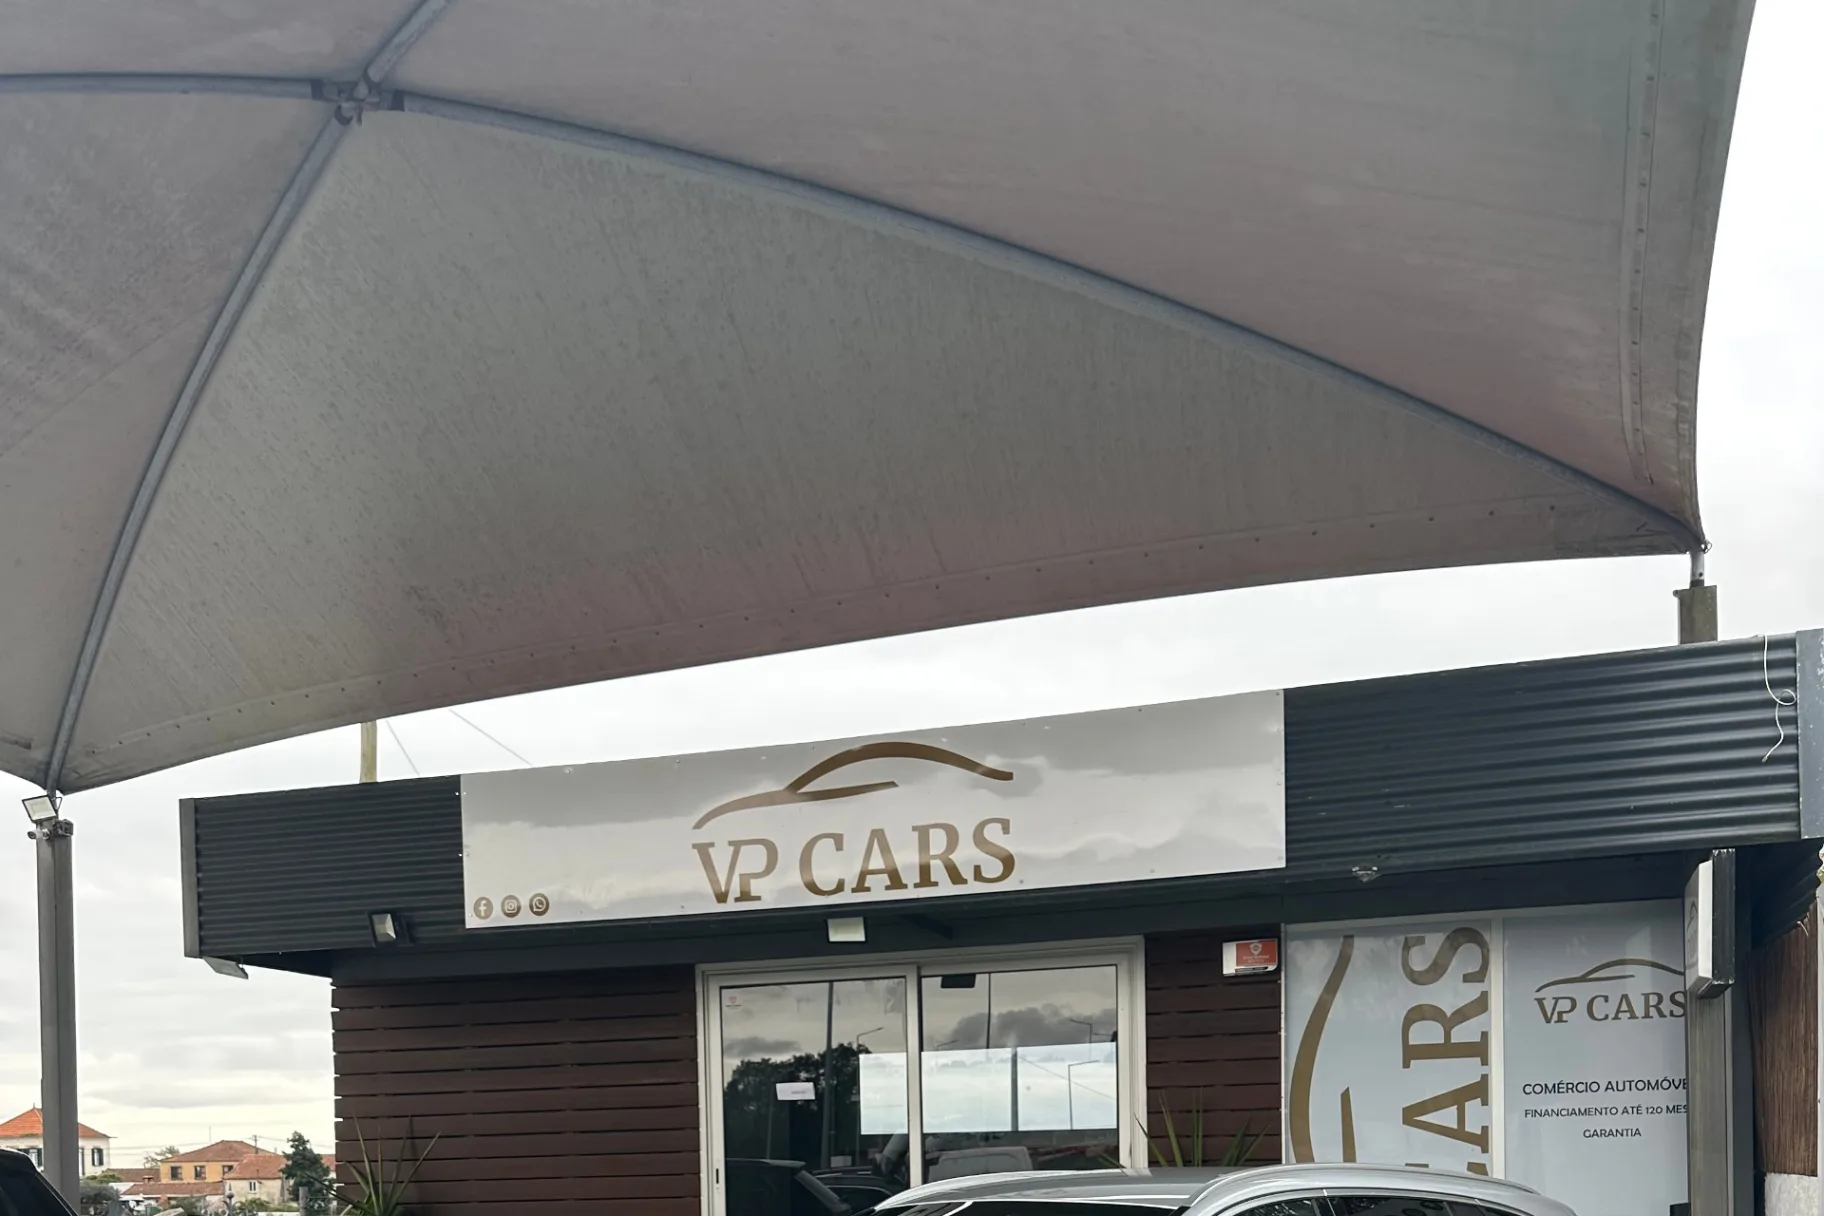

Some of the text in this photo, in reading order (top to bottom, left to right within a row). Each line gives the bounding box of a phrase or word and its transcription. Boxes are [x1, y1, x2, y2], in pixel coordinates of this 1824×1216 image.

[691, 817, 1016, 904] VP CARS
[1534, 990, 1686, 1024] VP CARS
[1401, 926, 1490, 1177] ARS
[1522, 1080, 1600, 1096] COMÉRCIO
[1524, 1106, 1619, 1118] FINANCIAMENTO
[1621, 1104, 1643, 1116] ATÉ
[1645, 1106, 1663, 1115] 120
[1582, 1127, 1642, 1139] GARANTIA
